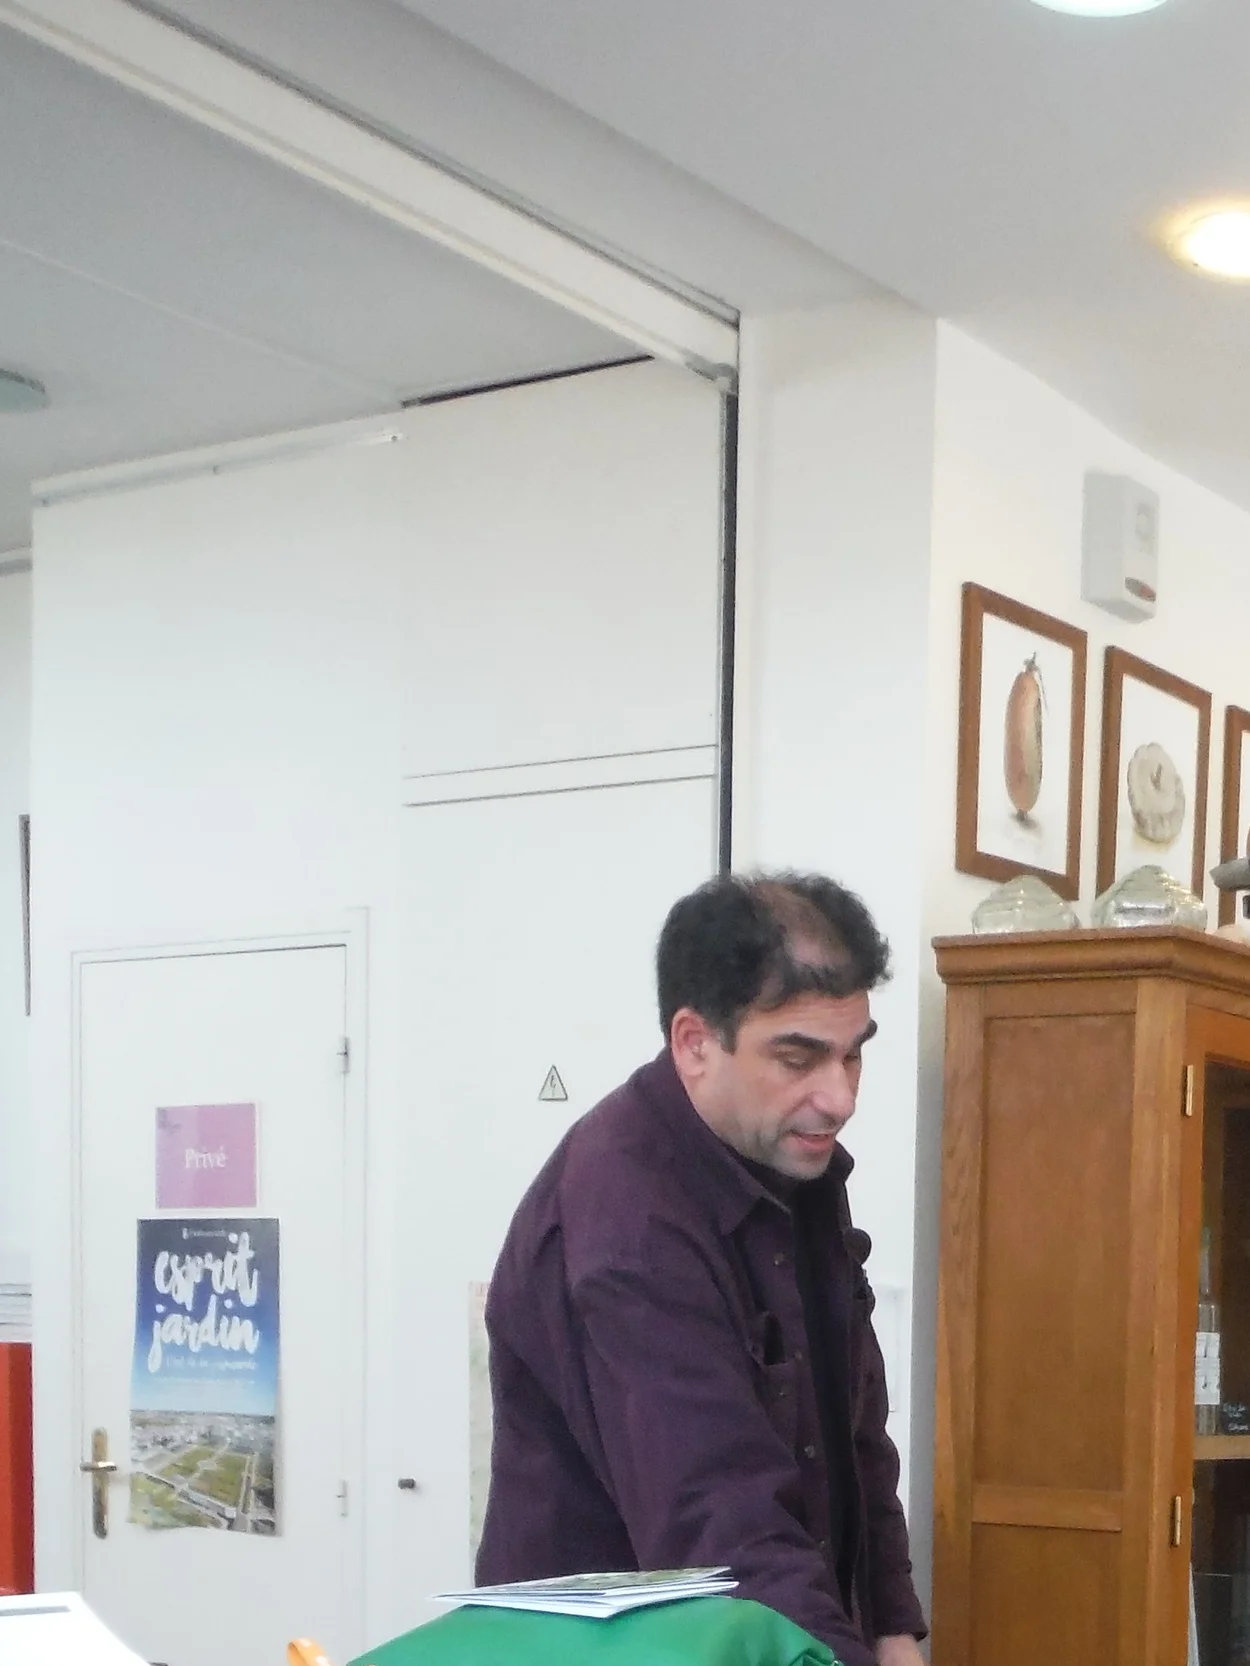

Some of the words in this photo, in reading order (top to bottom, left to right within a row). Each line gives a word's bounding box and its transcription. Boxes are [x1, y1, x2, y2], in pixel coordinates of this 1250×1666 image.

[184, 1145, 228, 1168] Privé
[154, 1231, 259, 1311] esprit
[147, 1293, 261, 1373] jardin
